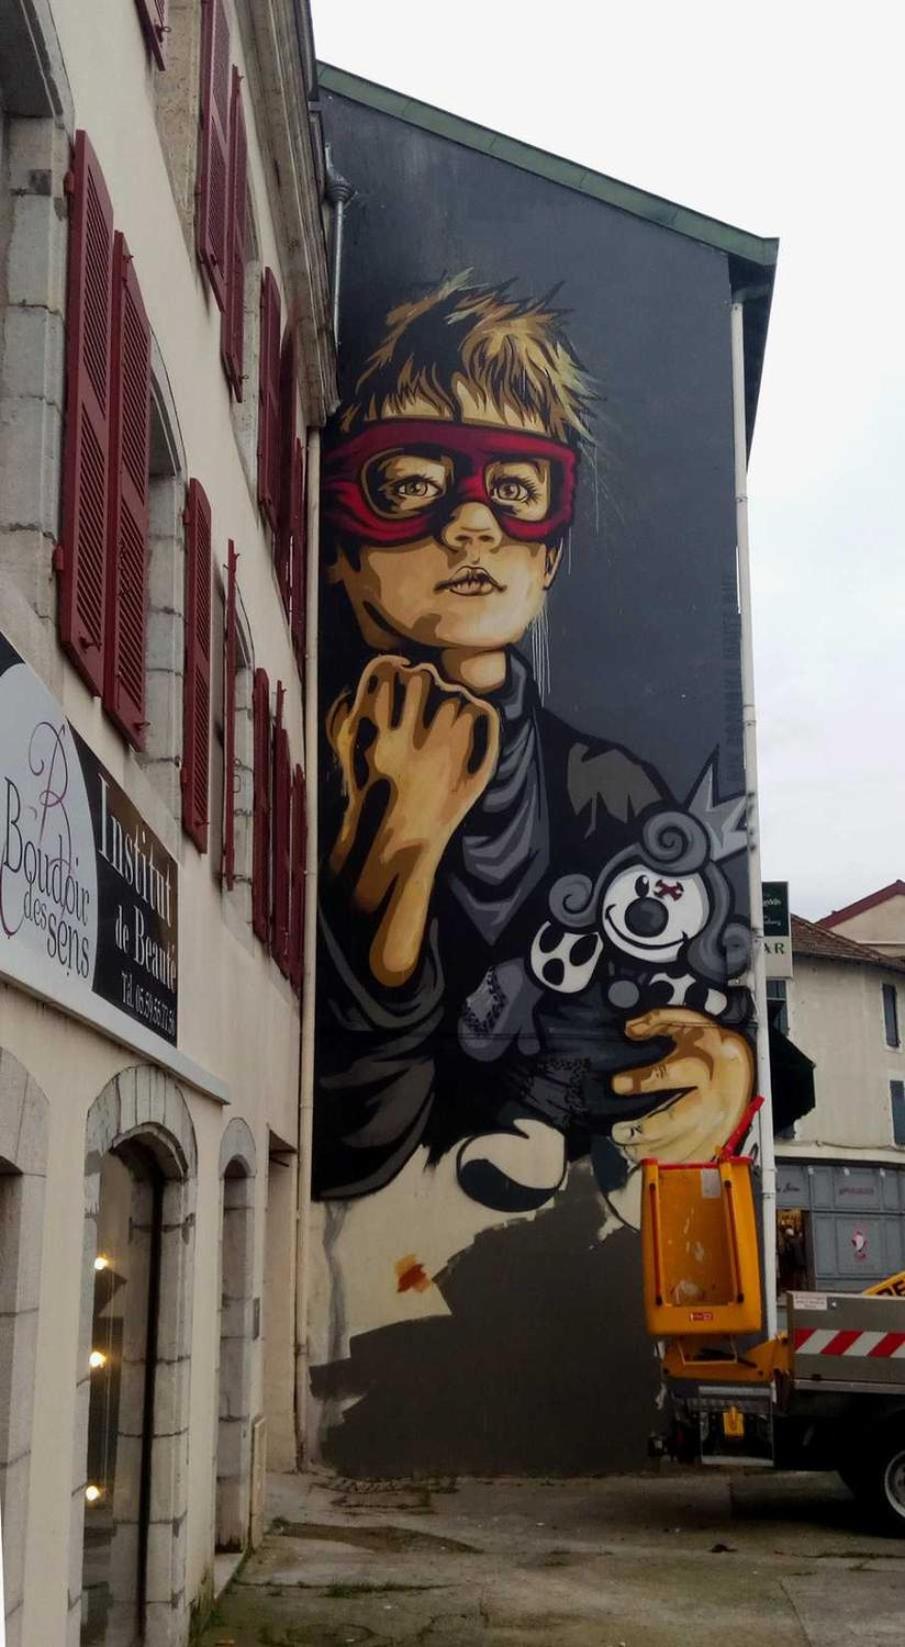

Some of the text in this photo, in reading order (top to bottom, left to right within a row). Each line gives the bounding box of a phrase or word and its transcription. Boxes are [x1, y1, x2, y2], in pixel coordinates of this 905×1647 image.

[4, 776, 90, 927] Boudoir
[97, 773, 172, 928] Institut
[23, 871, 47, 930] des
[46, 912, 90, 979] sens
[115, 904, 177, 994] de Beauté
